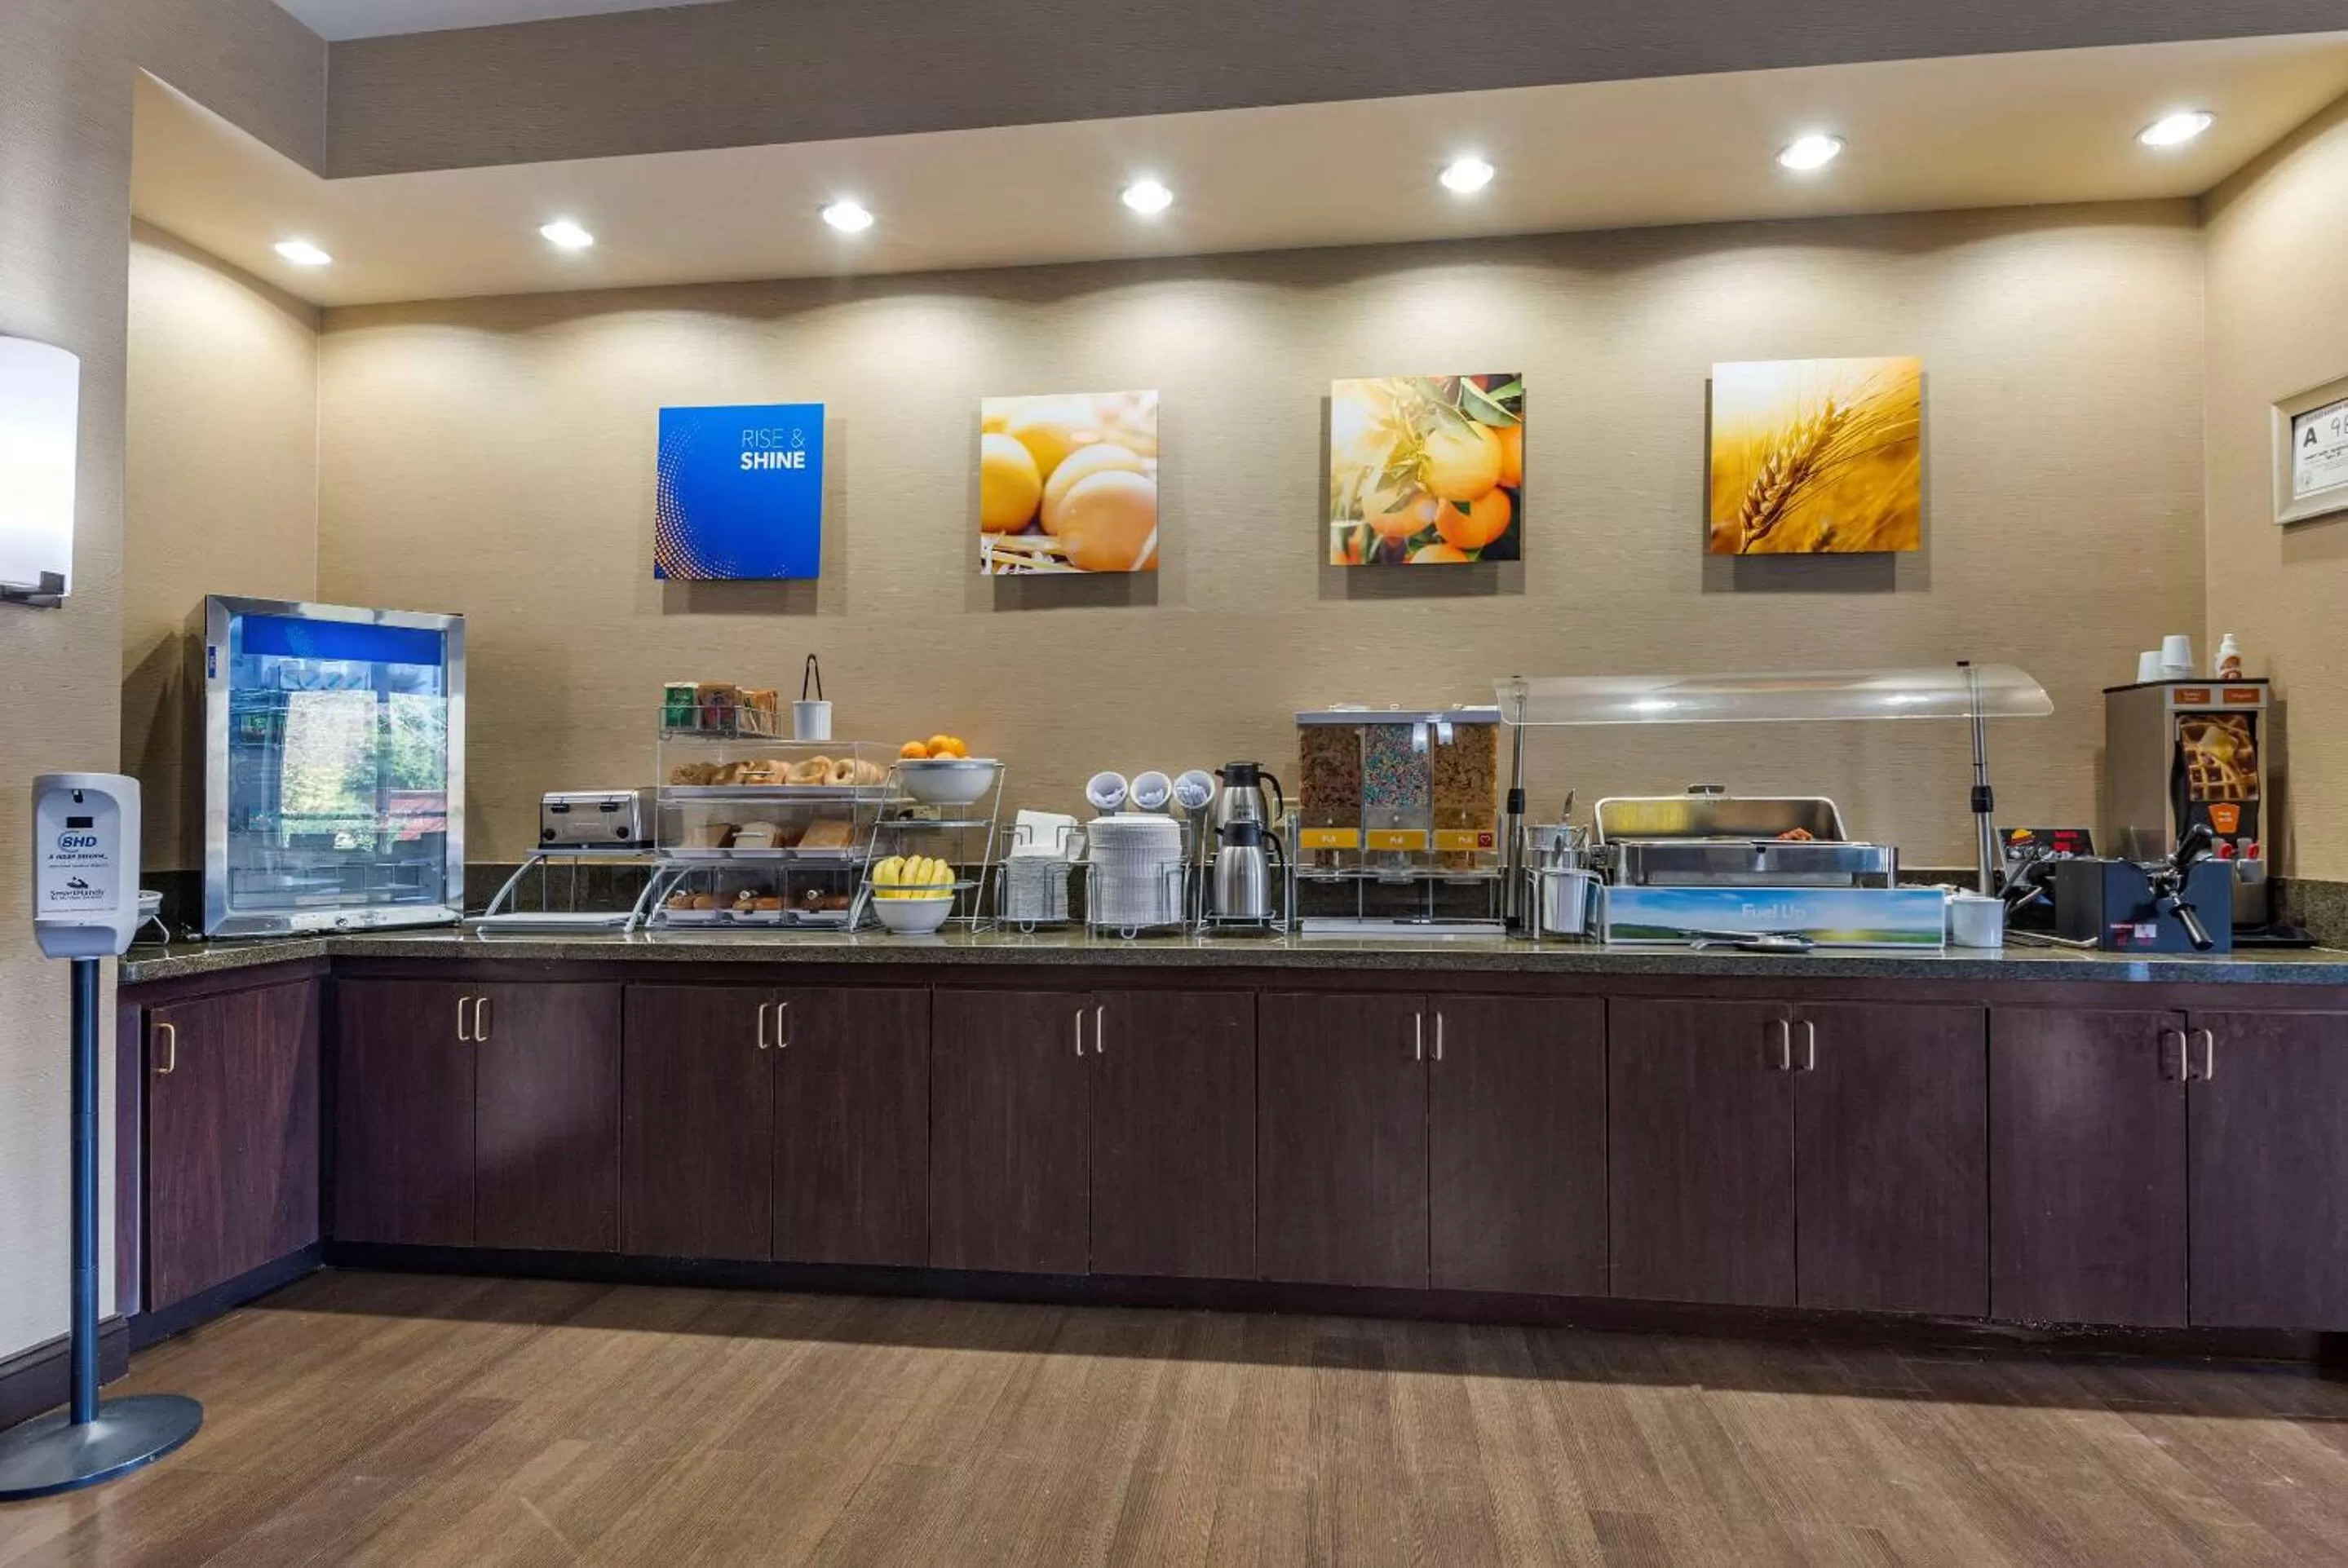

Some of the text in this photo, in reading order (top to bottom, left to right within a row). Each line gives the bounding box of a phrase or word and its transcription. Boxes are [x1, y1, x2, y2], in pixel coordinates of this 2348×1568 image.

[741, 428, 806, 449] RISE &
[2303, 426, 2317, 448] A
[740, 451, 806, 470] SHINE
[1741, 903, 1778, 919] Fuel
